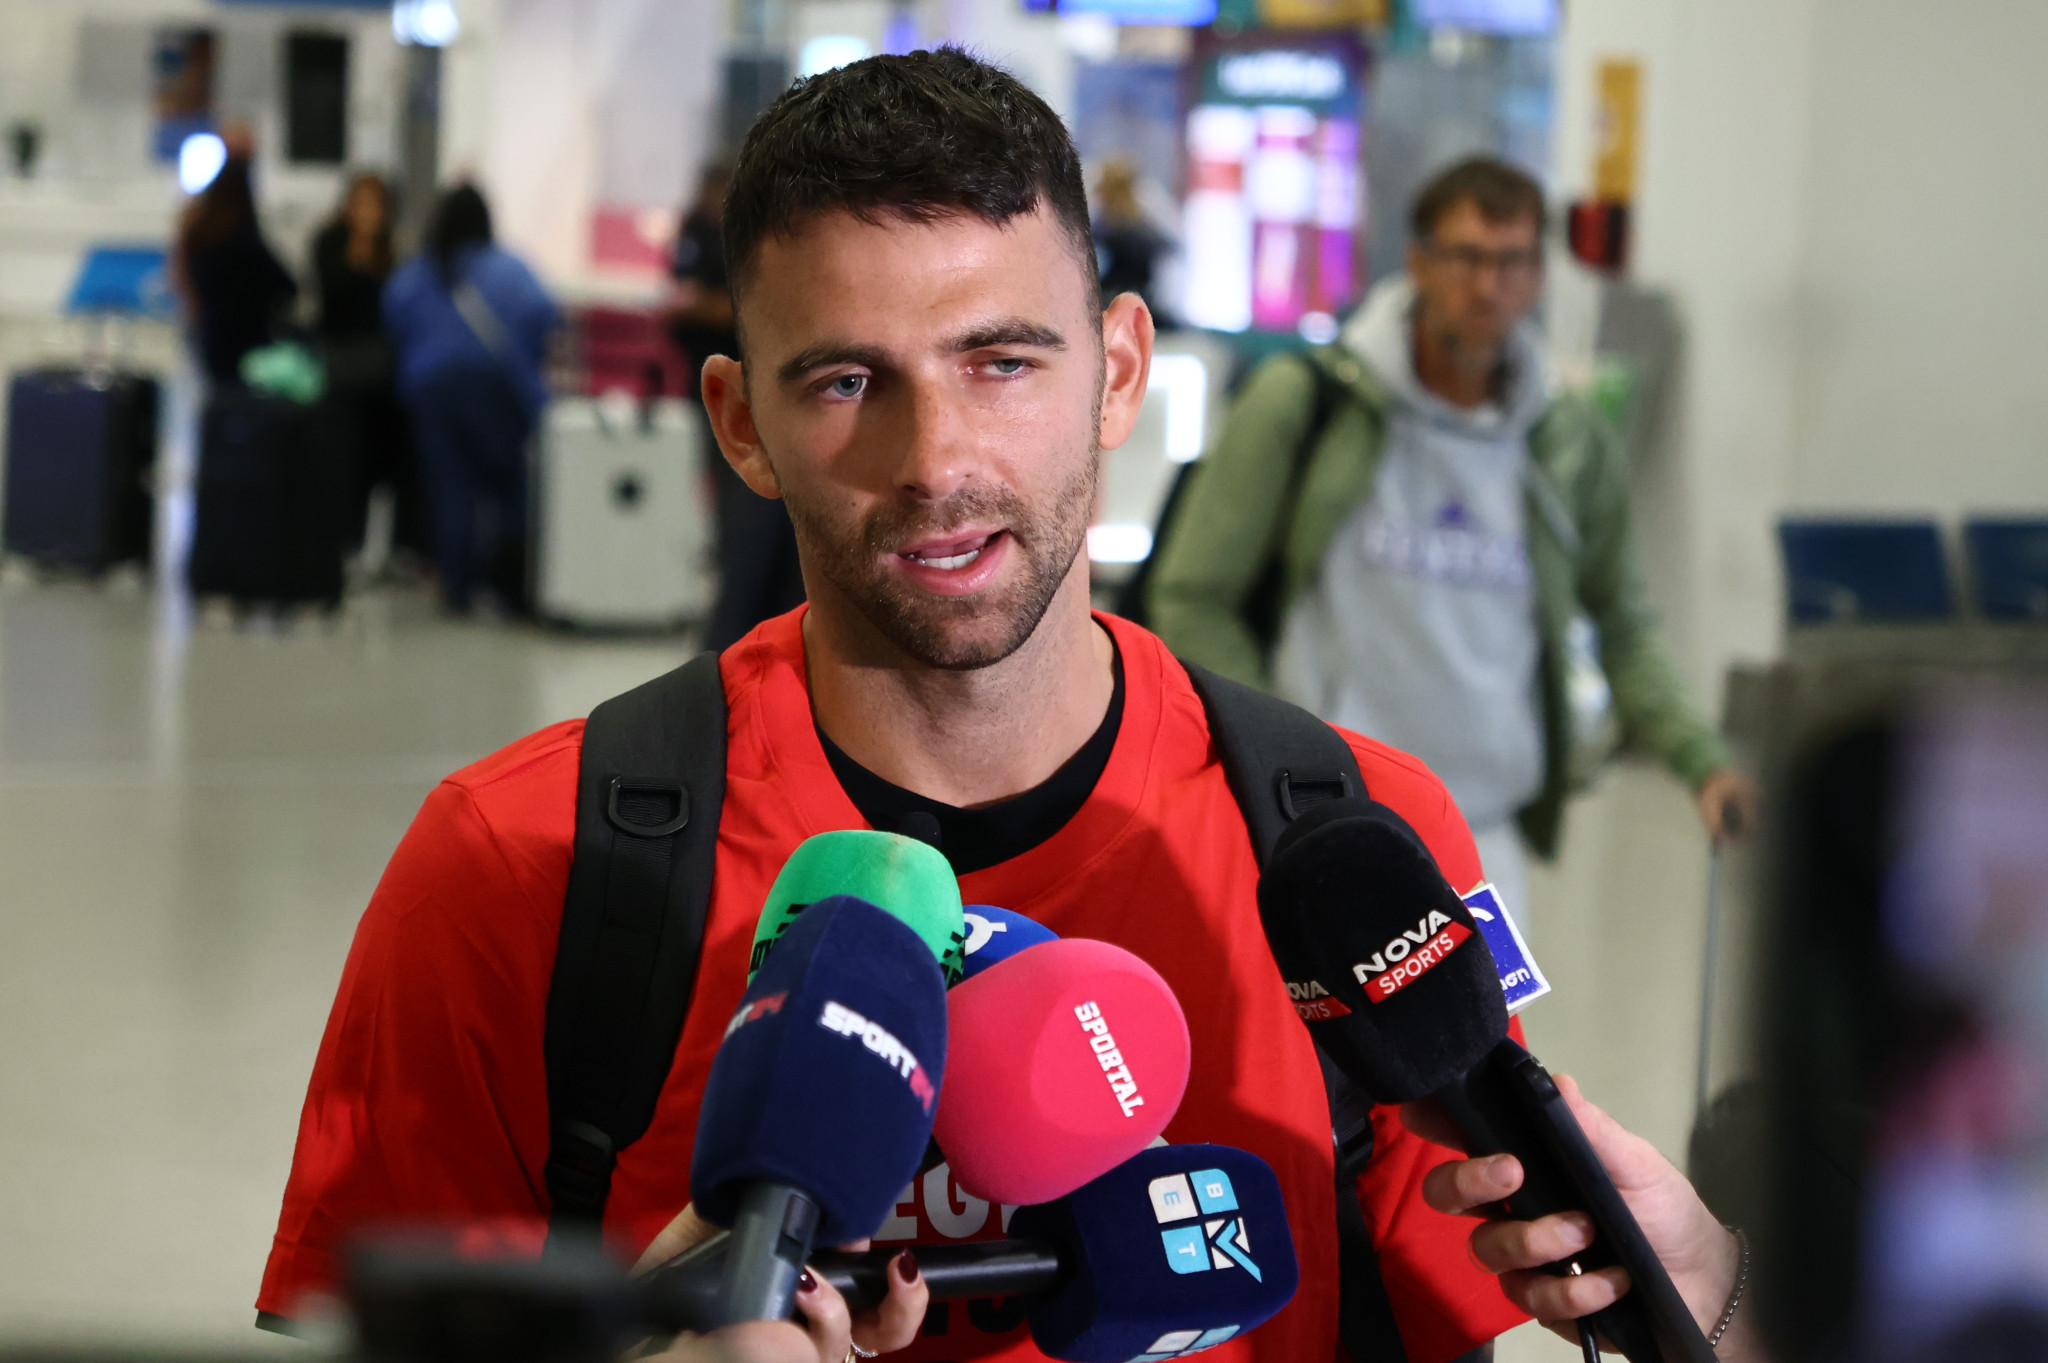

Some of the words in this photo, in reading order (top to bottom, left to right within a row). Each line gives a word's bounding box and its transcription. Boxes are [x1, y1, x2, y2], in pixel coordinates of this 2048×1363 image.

[1352, 909, 1451, 984] NOVA
[1378, 933, 1454, 994] SPORTS
[1073, 1000, 1144, 1118] SPORTAL
